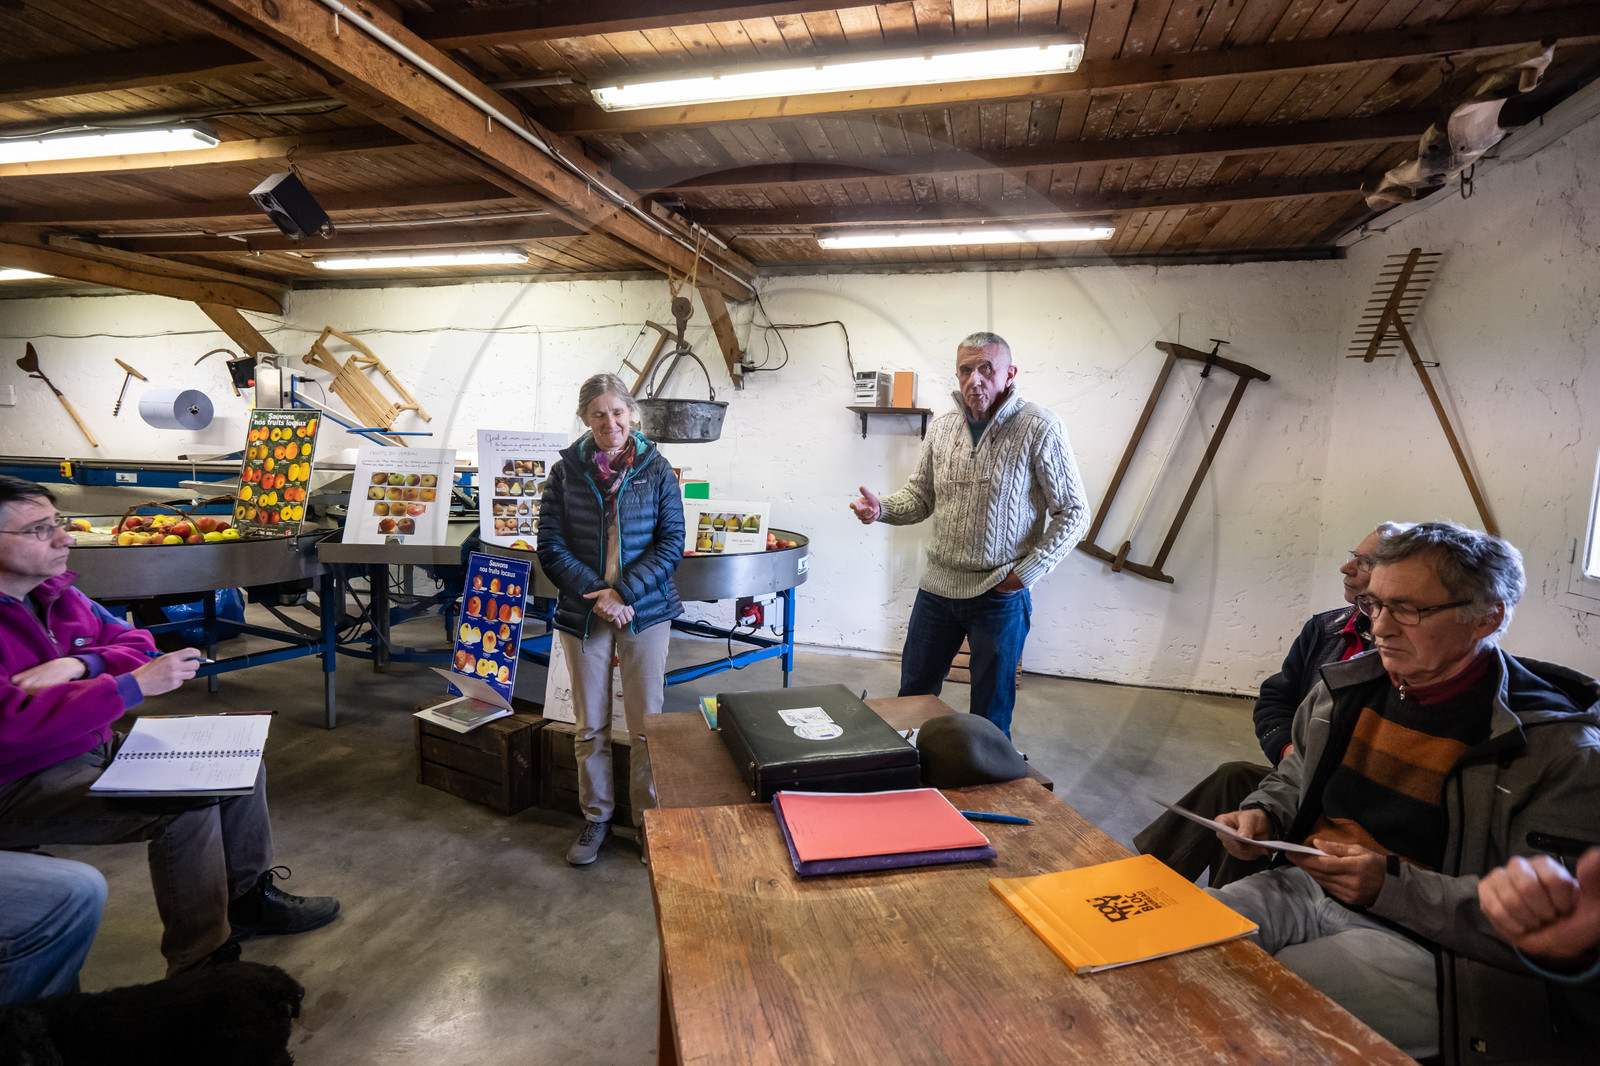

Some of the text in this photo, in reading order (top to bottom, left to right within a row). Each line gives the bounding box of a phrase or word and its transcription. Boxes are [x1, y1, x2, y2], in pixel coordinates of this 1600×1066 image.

[489, 560, 508, 569] Sauvons
[488, 567, 500, 575] fruits
[501, 570, 516, 578] locaux
[1124, 893, 1154, 912] BLOC
[1136, 890, 1162, 909] BUREAU
